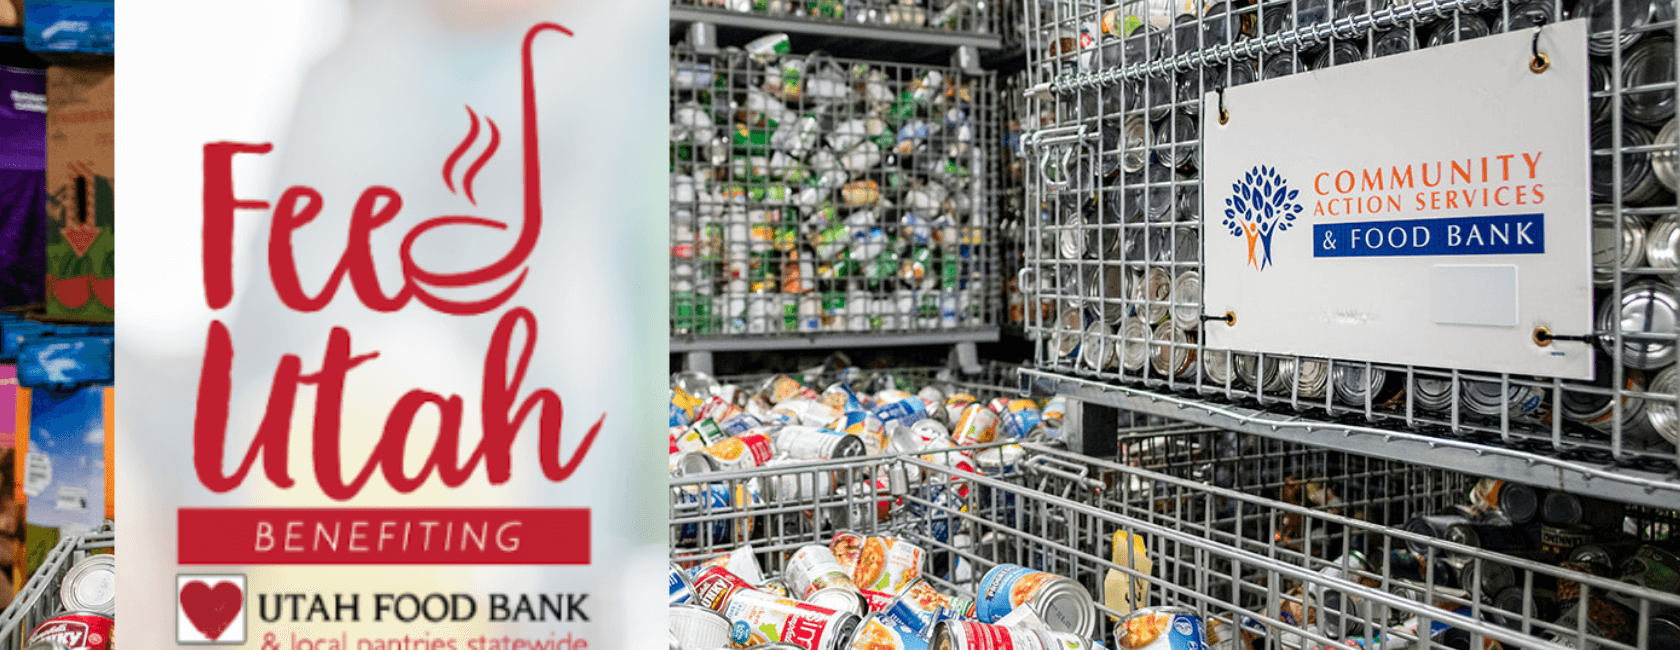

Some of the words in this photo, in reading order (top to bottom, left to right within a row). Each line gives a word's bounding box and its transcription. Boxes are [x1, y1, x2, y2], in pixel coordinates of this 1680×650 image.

[1313, 151, 1542, 196] COMMUNITY
[1313, 195, 1401, 217] ACTION
[1415, 184, 1545, 212] SERVICES
[1322, 230, 1337, 250] &
[1351, 226, 1431, 249] FOOD
[1447, 222, 1534, 247] BANK
